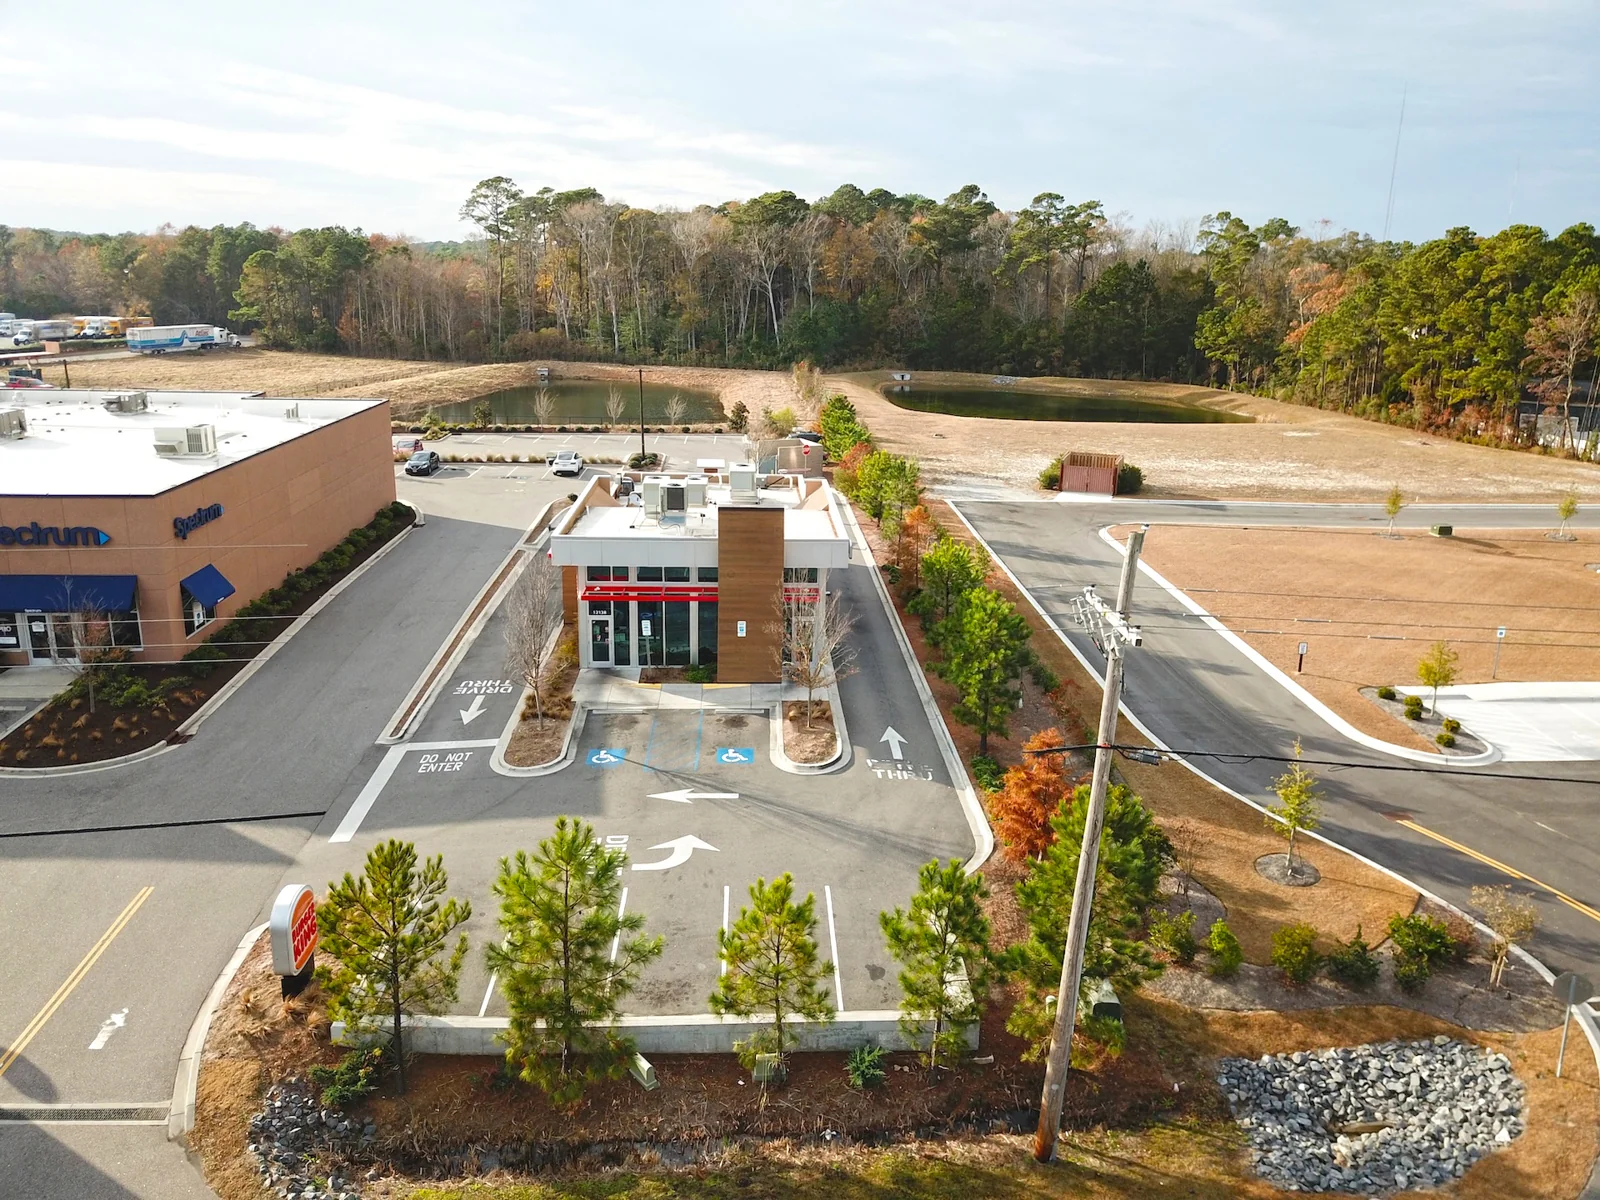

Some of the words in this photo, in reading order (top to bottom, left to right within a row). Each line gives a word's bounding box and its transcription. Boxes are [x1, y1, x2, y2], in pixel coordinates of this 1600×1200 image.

[174, 503, 222, 540] Spectrum
[453, 686, 513, 695] DRIVE
[419, 754, 439, 764] DO
[445, 752, 473, 762] NOT
[418, 762, 463, 773] ENTER
[293, 915, 317, 963] KING
